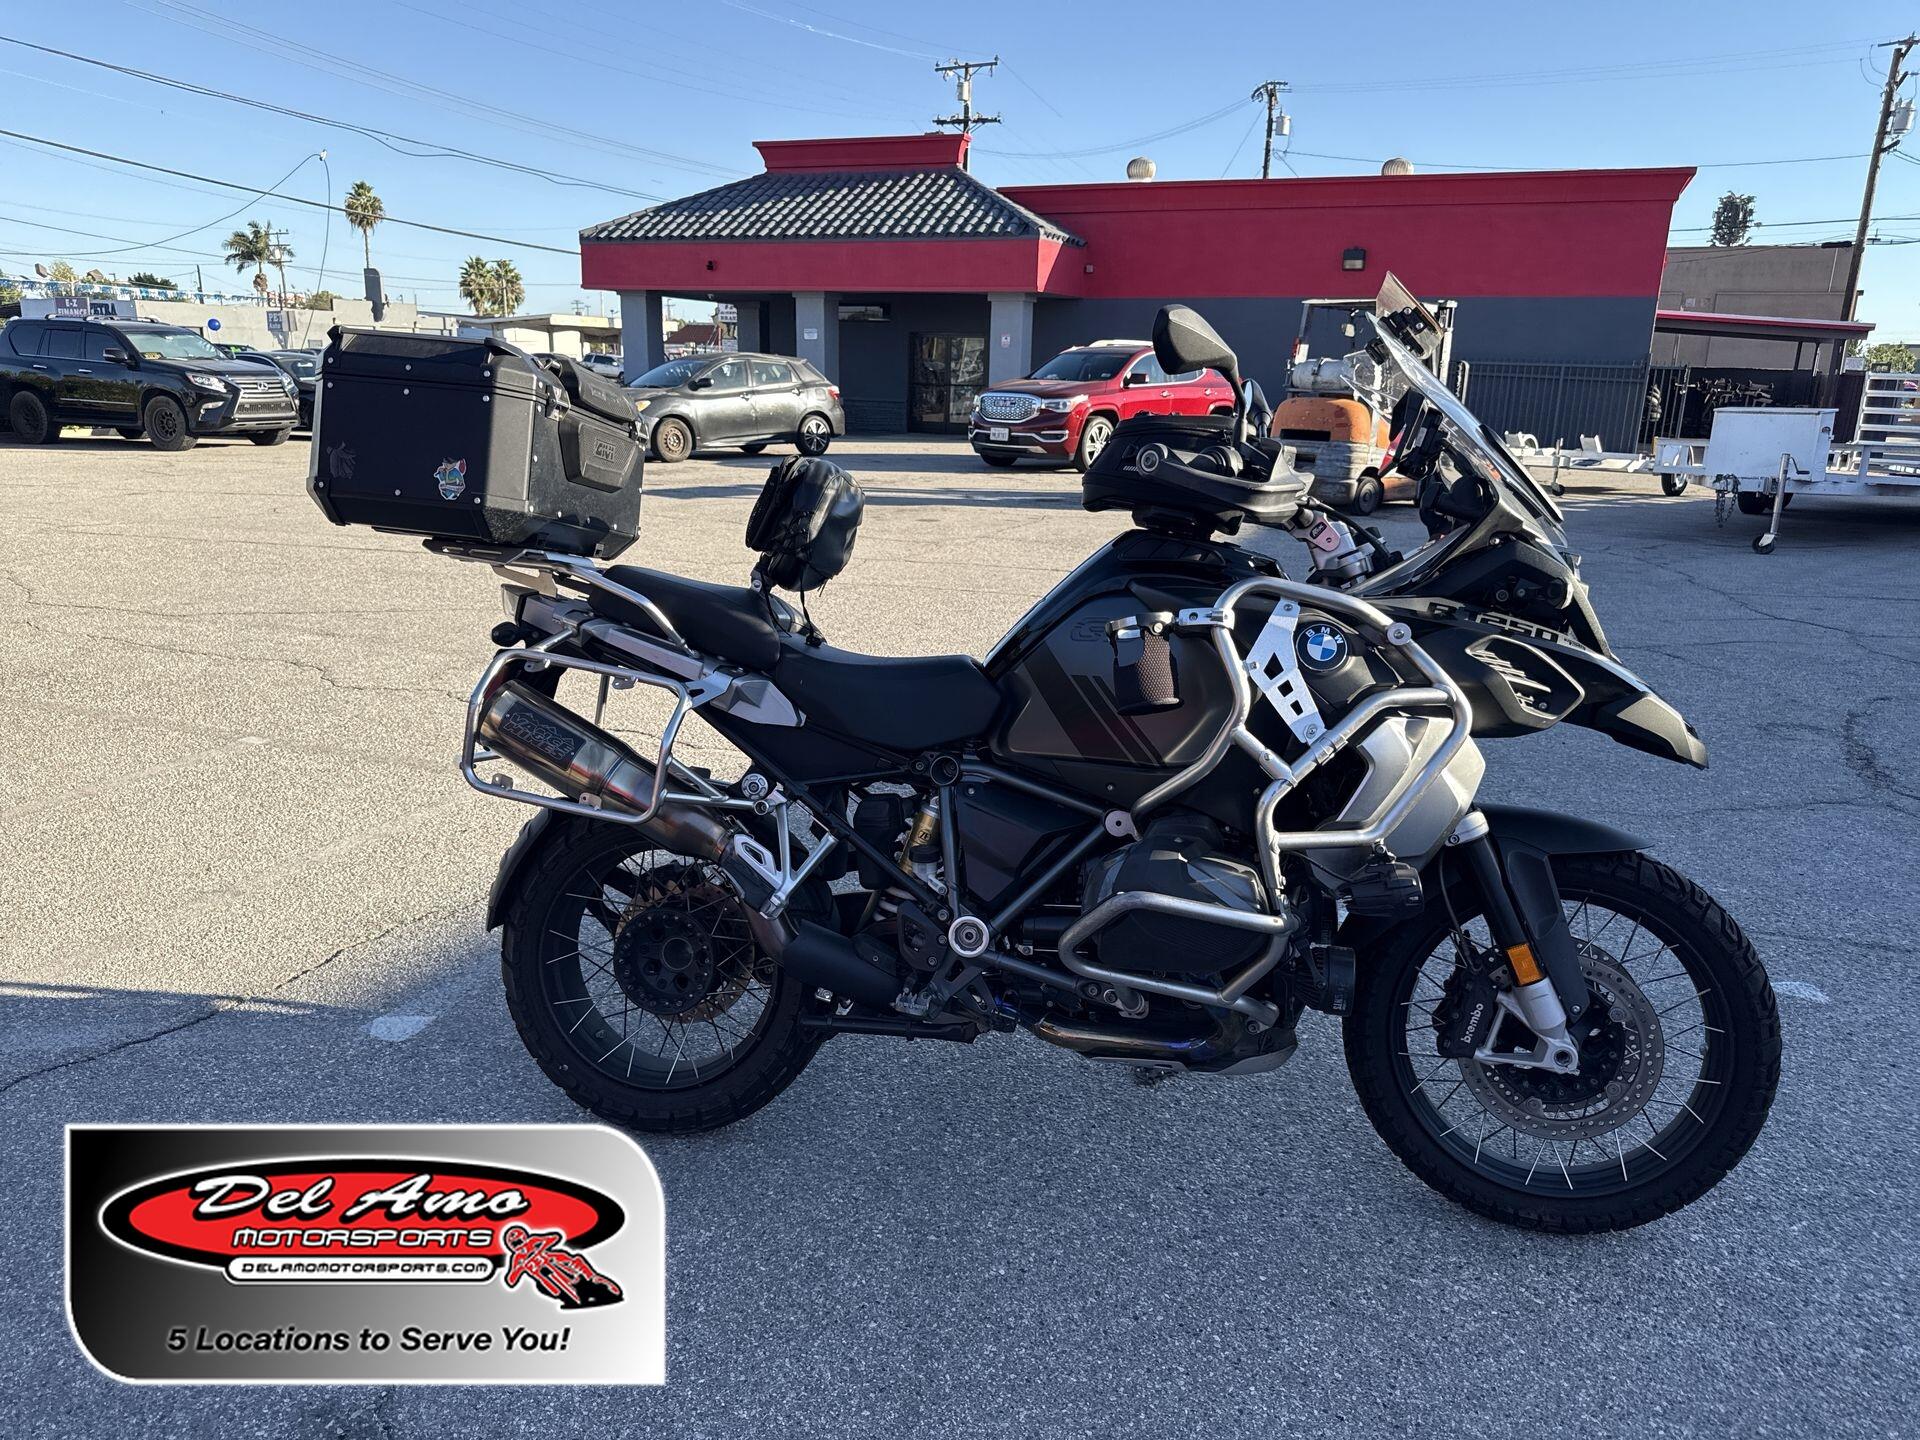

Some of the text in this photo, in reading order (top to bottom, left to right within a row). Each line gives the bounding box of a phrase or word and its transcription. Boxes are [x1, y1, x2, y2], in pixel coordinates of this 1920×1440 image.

[57, 308, 88, 316] FINANCE
[65, 299, 77, 307] E-Z
[595, 442, 615, 461] GIVI
[1305, 626, 1344, 644] BMW
[1461, 1003, 1484, 1043] brembo
